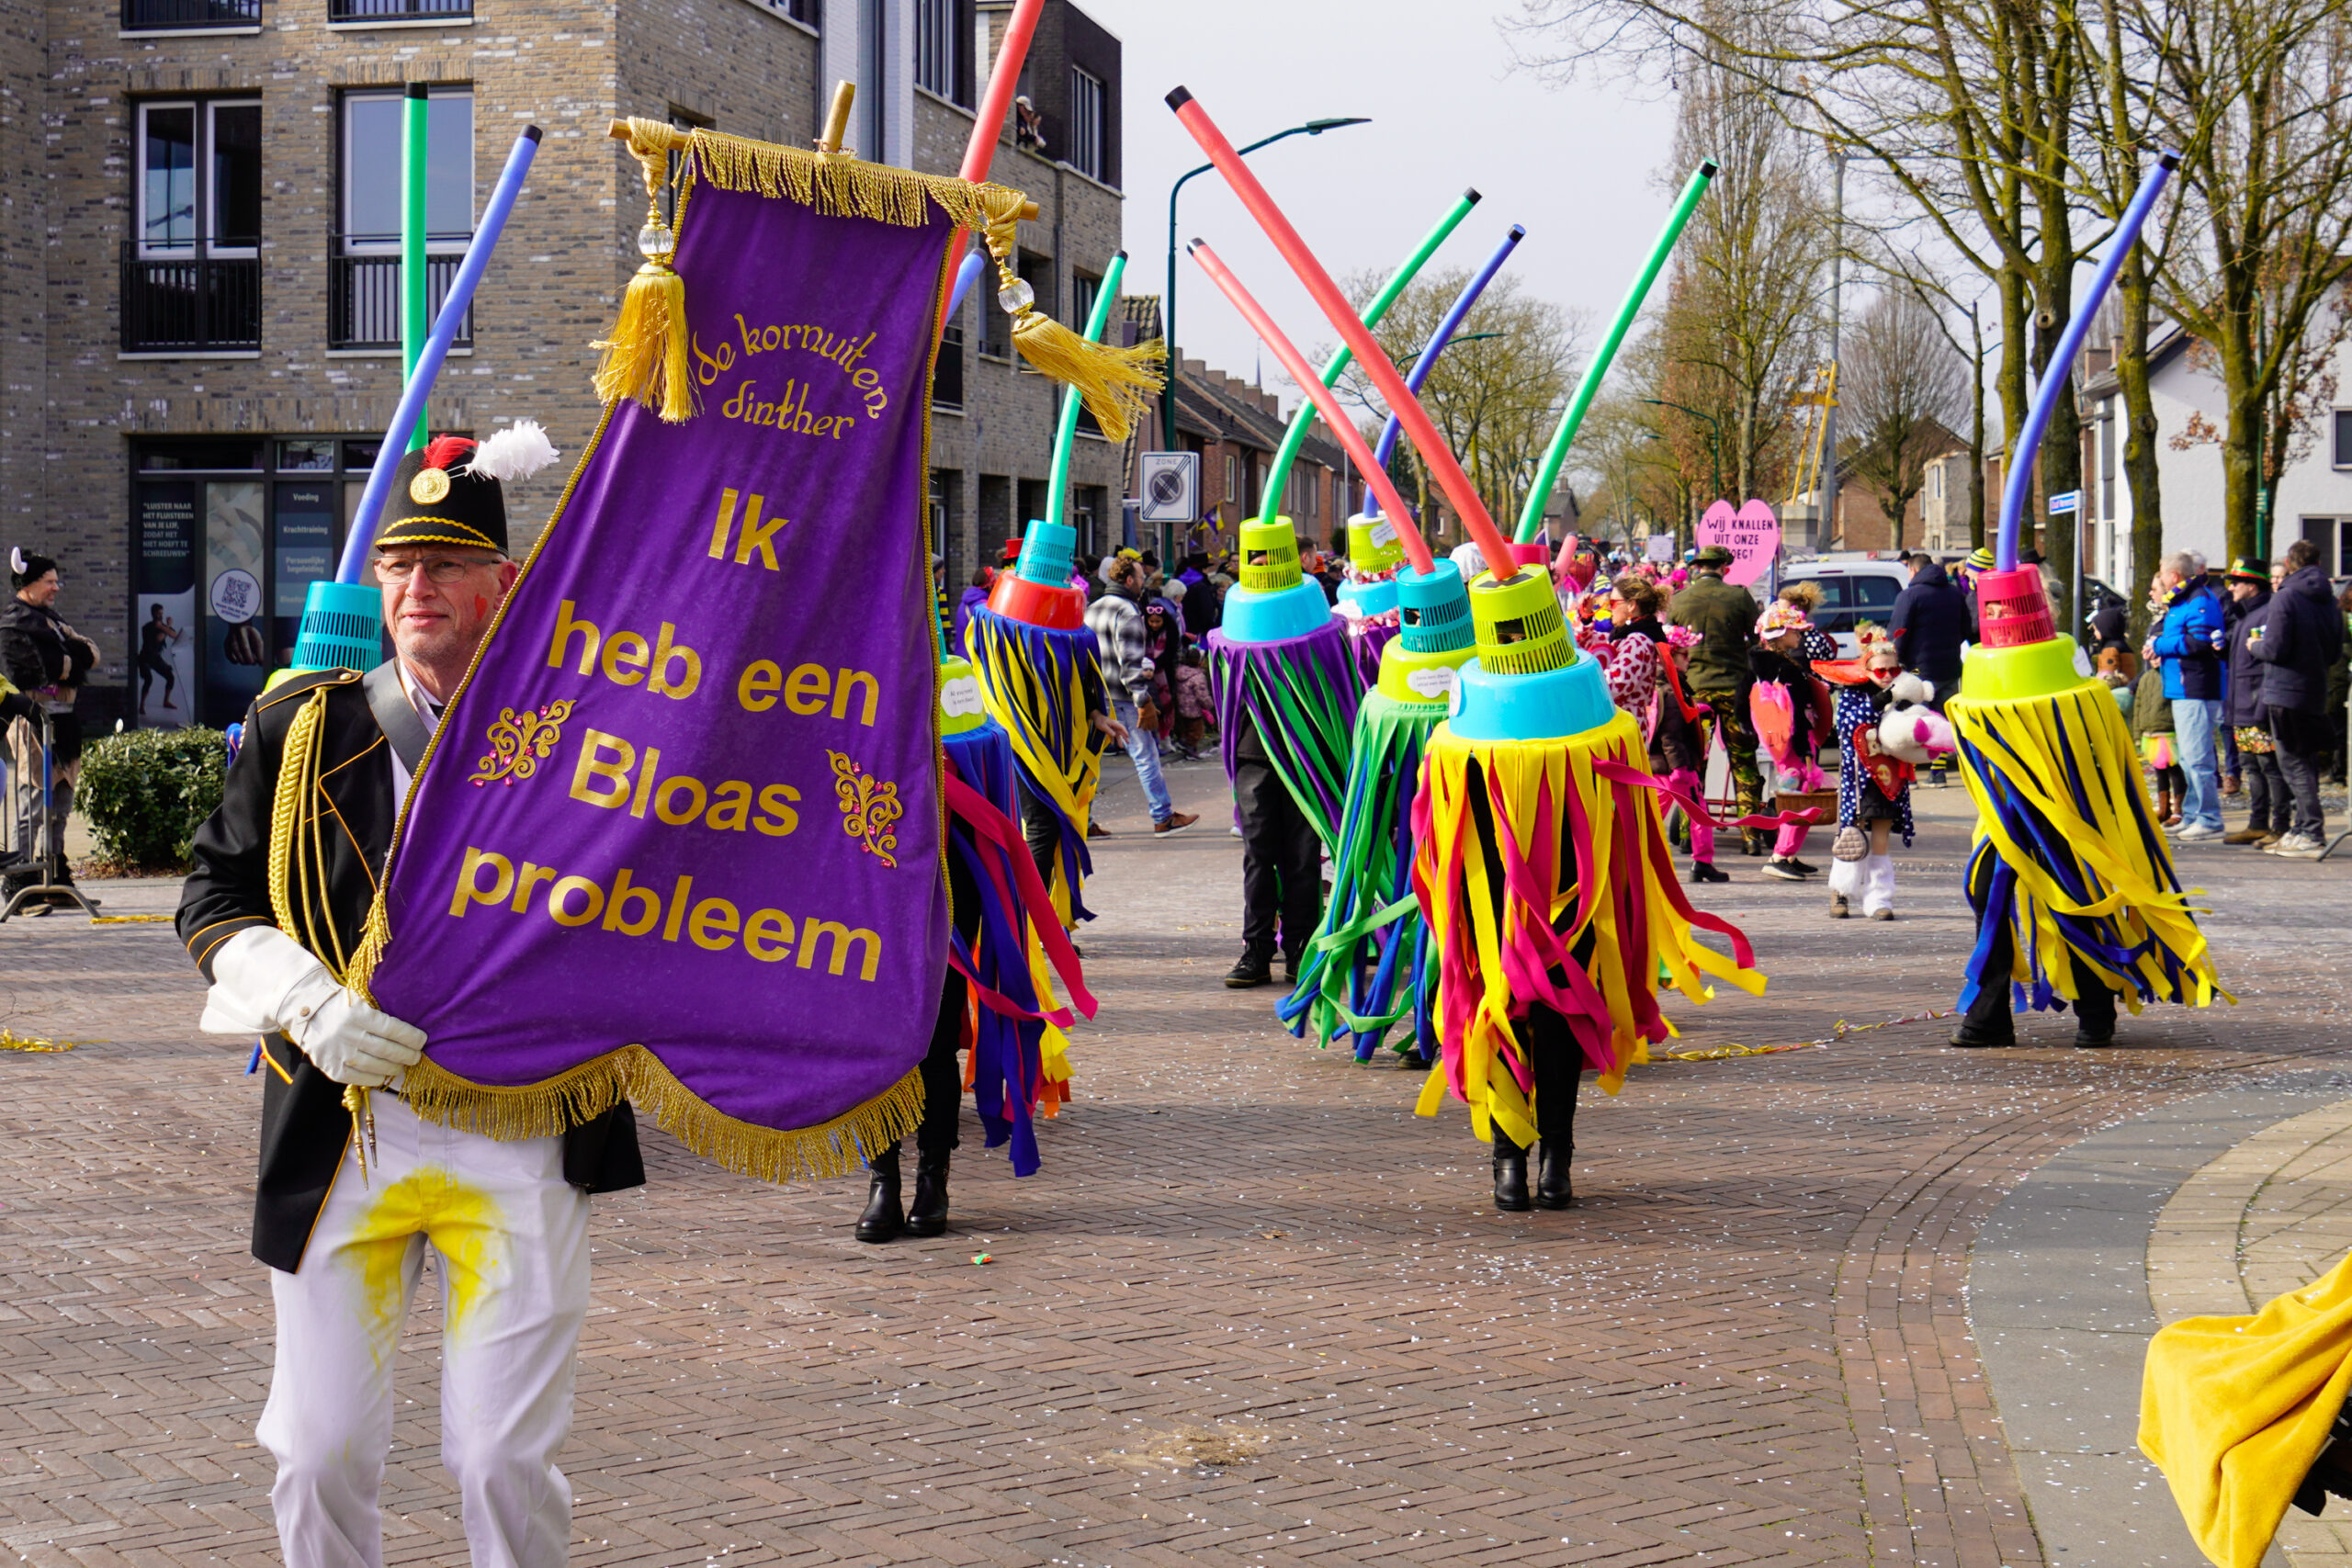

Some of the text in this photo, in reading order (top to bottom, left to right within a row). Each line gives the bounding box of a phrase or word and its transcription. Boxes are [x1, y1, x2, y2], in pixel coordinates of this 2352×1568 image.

[692, 313, 888, 420] de kornuiten
[722, 378, 854, 439] dinther
[142, 512, 194, 520] HET FLUISTEREN
[293, 493, 319, 502] Voeding
[1732, 520, 1773, 530] KNALLEN
[283, 525, 328, 535] Krachttraining
[707, 488, 789, 571] Ik
[1714, 534, 1758, 545] UIT ONZE
[547, 599, 880, 728] heb een
[568, 728, 802, 837] Bloas
[447, 845, 883, 982] probleem
